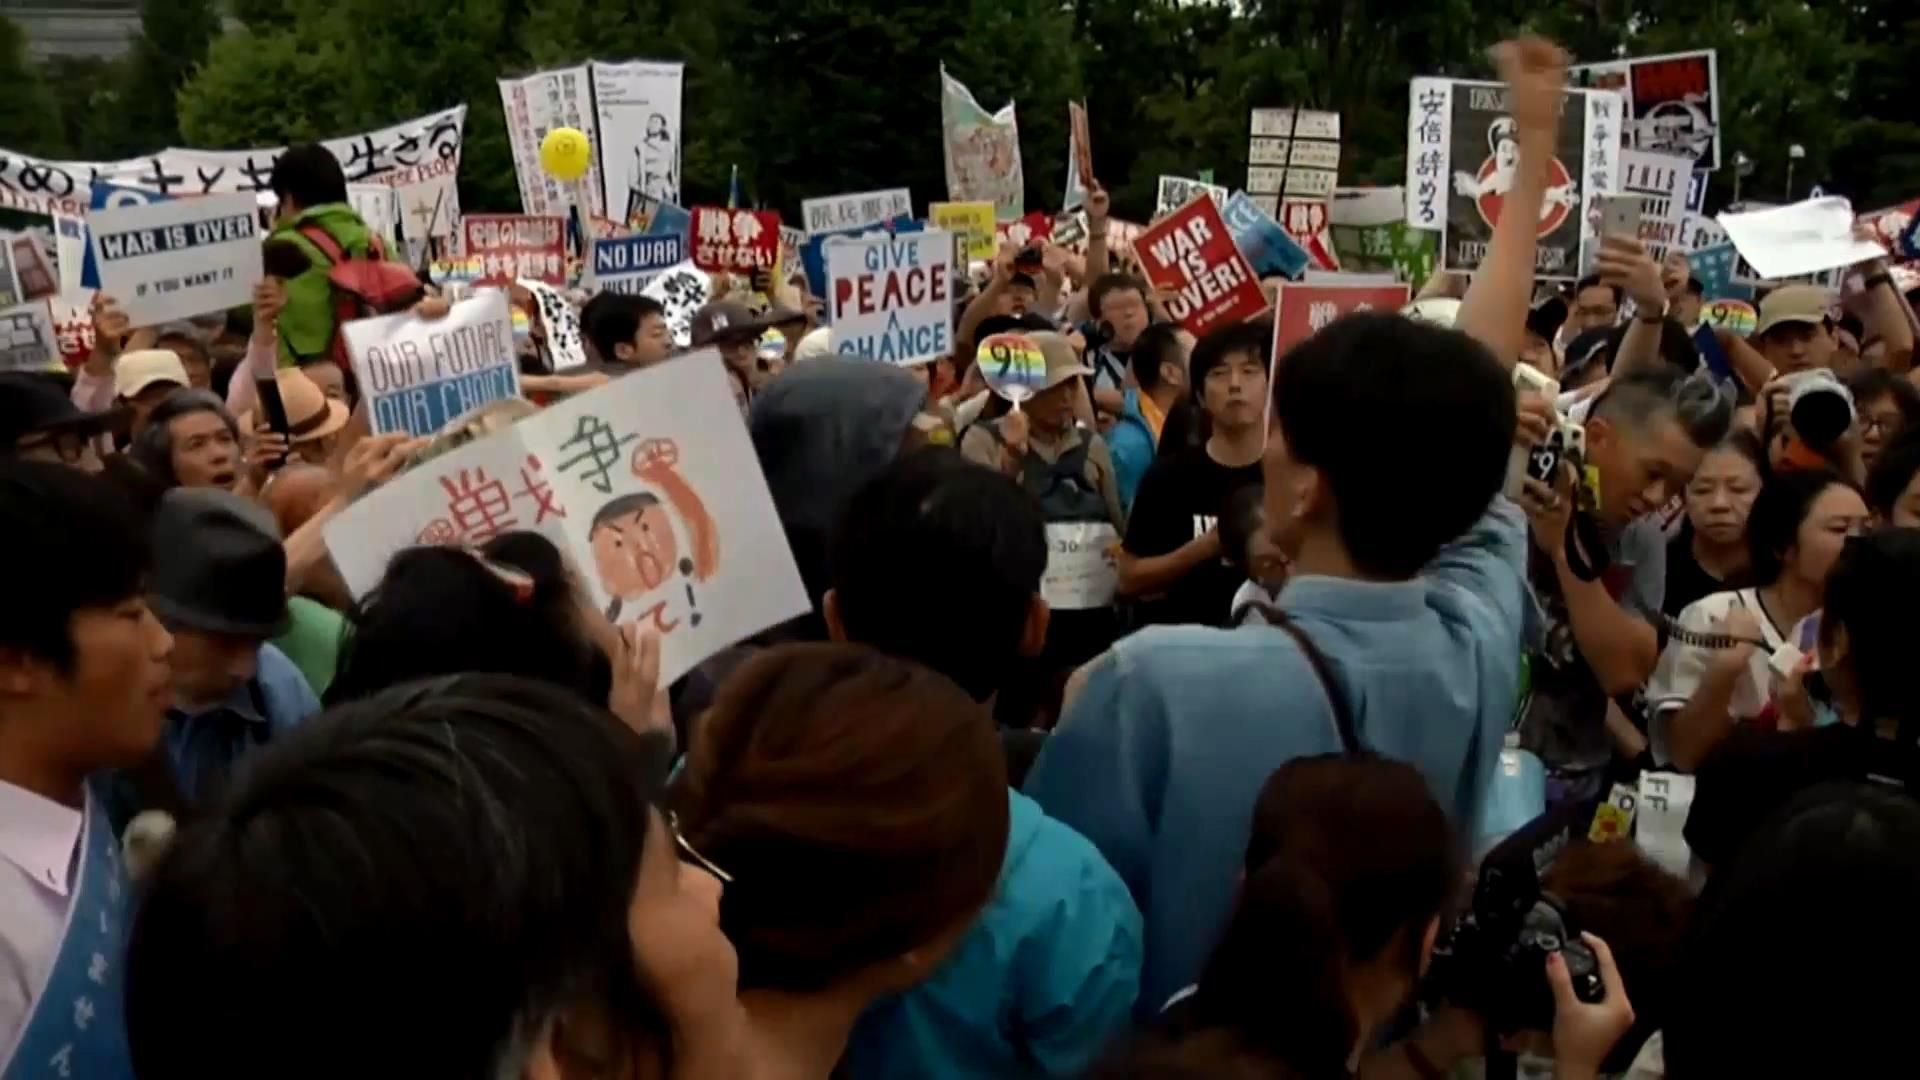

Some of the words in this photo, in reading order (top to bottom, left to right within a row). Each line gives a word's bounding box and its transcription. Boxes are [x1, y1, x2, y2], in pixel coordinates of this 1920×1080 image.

[1416, 87, 1446, 222] 安倍辞めろ
[104, 230, 156, 260] WAR
[163, 225, 187, 250] IS
[195, 214, 250, 244] OVER
[697, 207, 763, 243] 戦争
[1150, 215, 1213, 269] WAR
[597, 244, 627, 269] NO
[633, 238, 680, 266] WAR
[696, 244, 772, 268] させない
[864, 239, 919, 271] GIVE
[1178, 250, 1207, 282] IS
[136, 283, 148, 297] IF
[154, 277, 180, 294] YOU
[184, 270, 219, 289] WANT
[222, 267, 234, 281] IT
[835, 262, 946, 319] PEACE
[1168, 254, 1248, 320] OVER!
[838, 321, 946, 362] CHANCE
[887, 310, 900, 332] A
[367, 340, 426, 392] OUR
[429, 320, 508, 377] FUTURE
[375, 388, 434, 437] OUR
